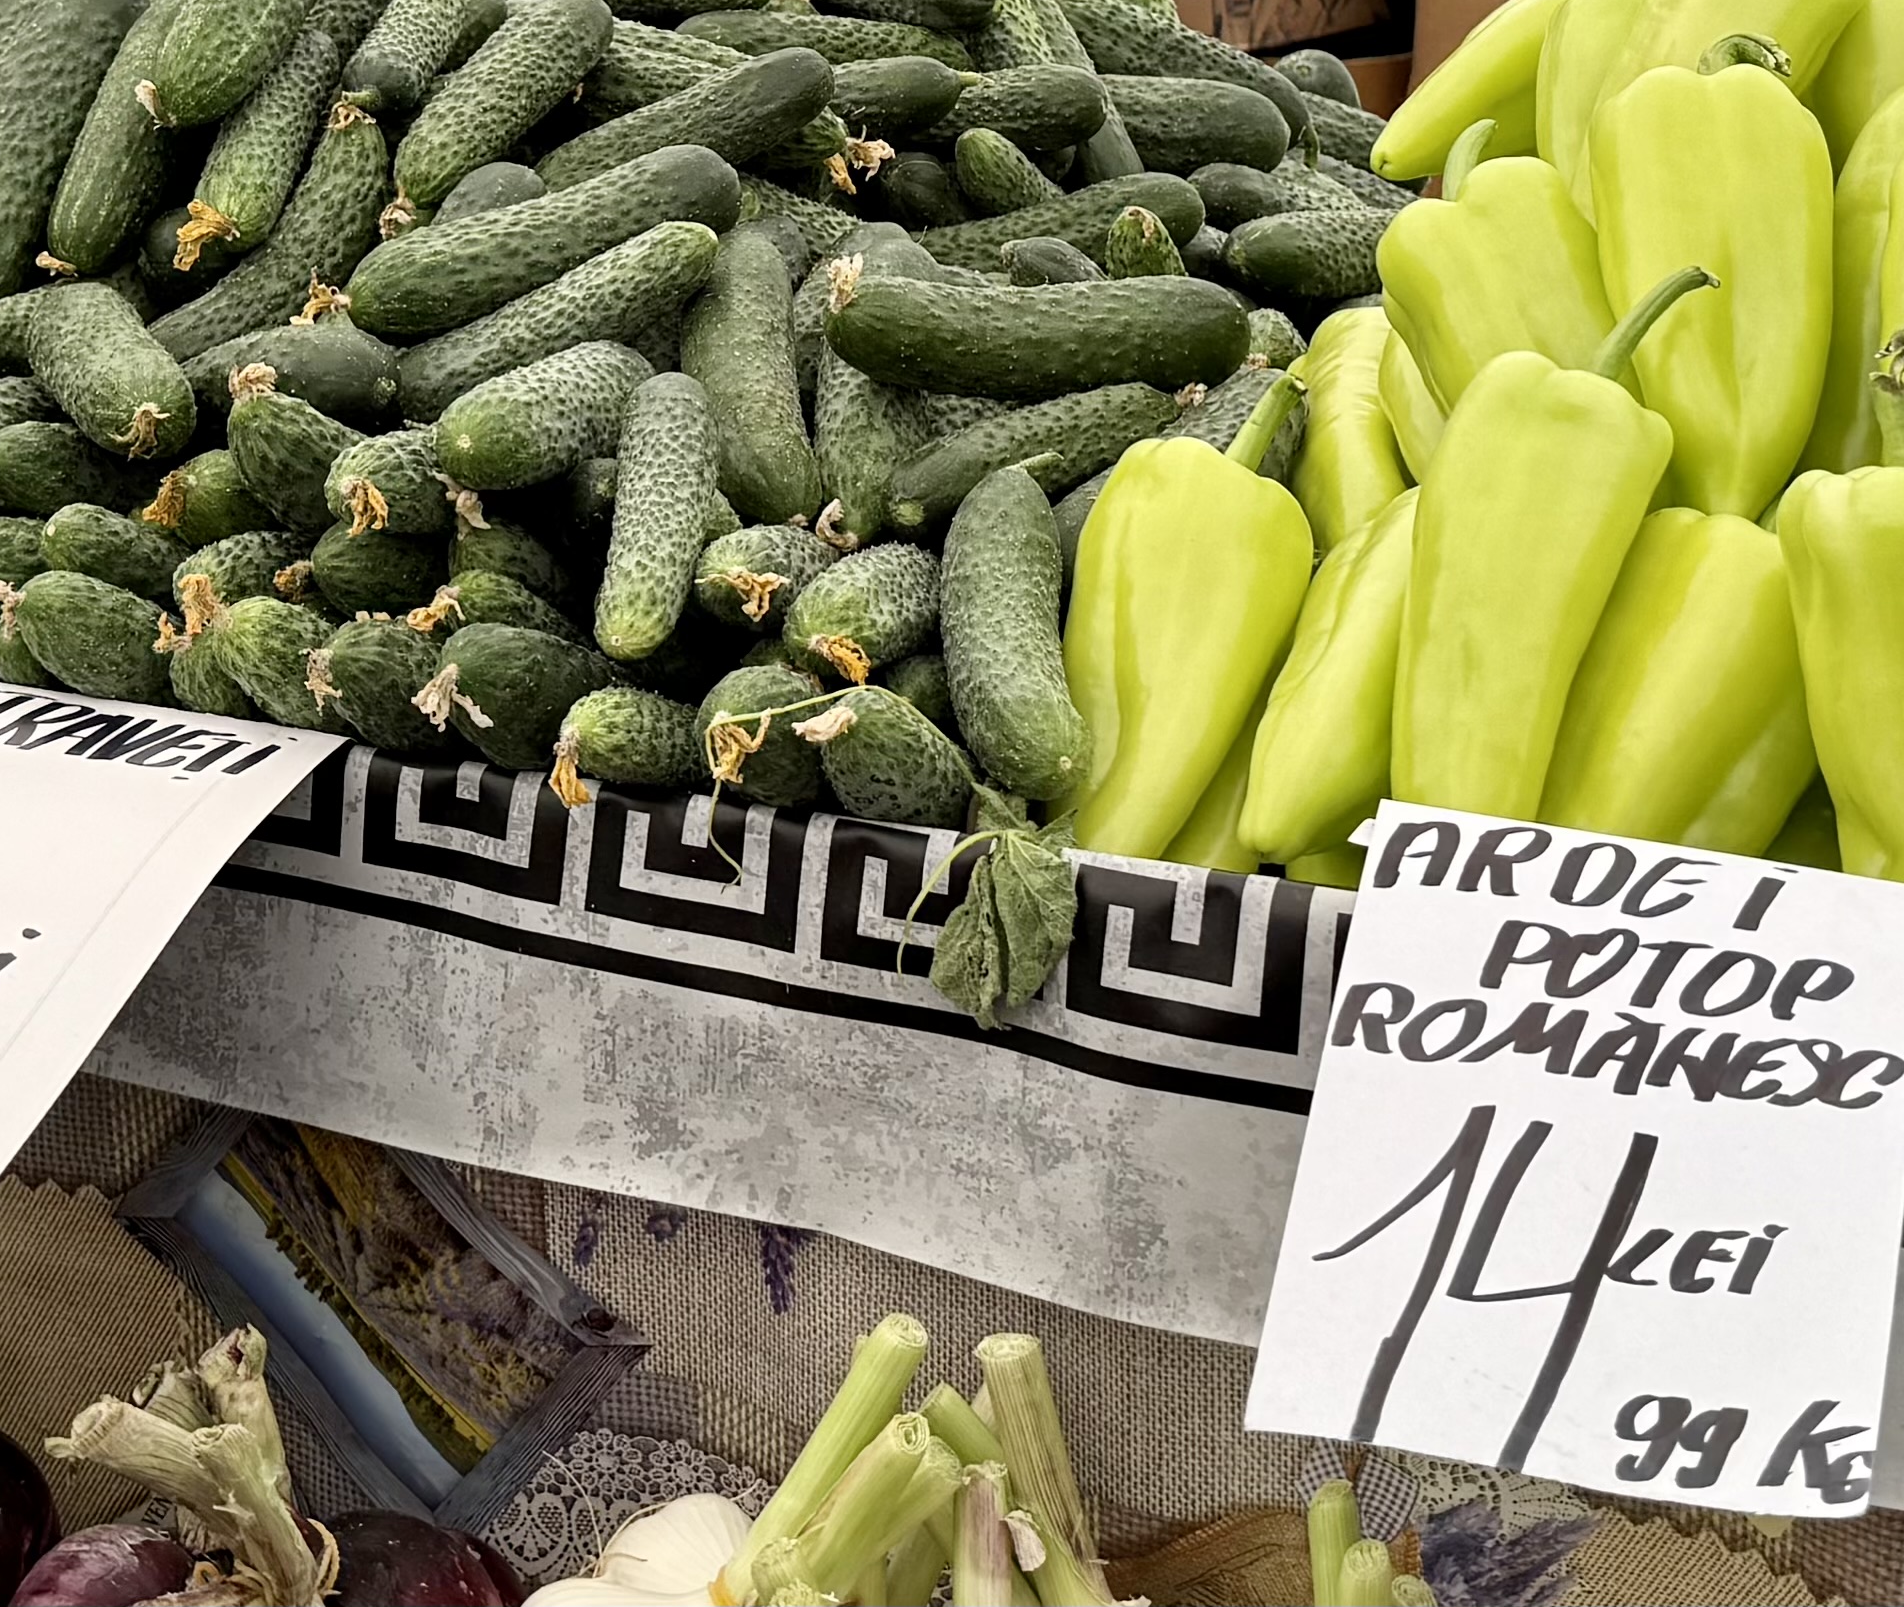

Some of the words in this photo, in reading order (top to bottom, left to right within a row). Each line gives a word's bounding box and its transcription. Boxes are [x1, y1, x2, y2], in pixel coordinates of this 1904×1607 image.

[1479, 919, 1856, 1021] POTOP
[1312, 1105, 1660, 1473] 14
[1614, 1394, 1749, 1489] 99
